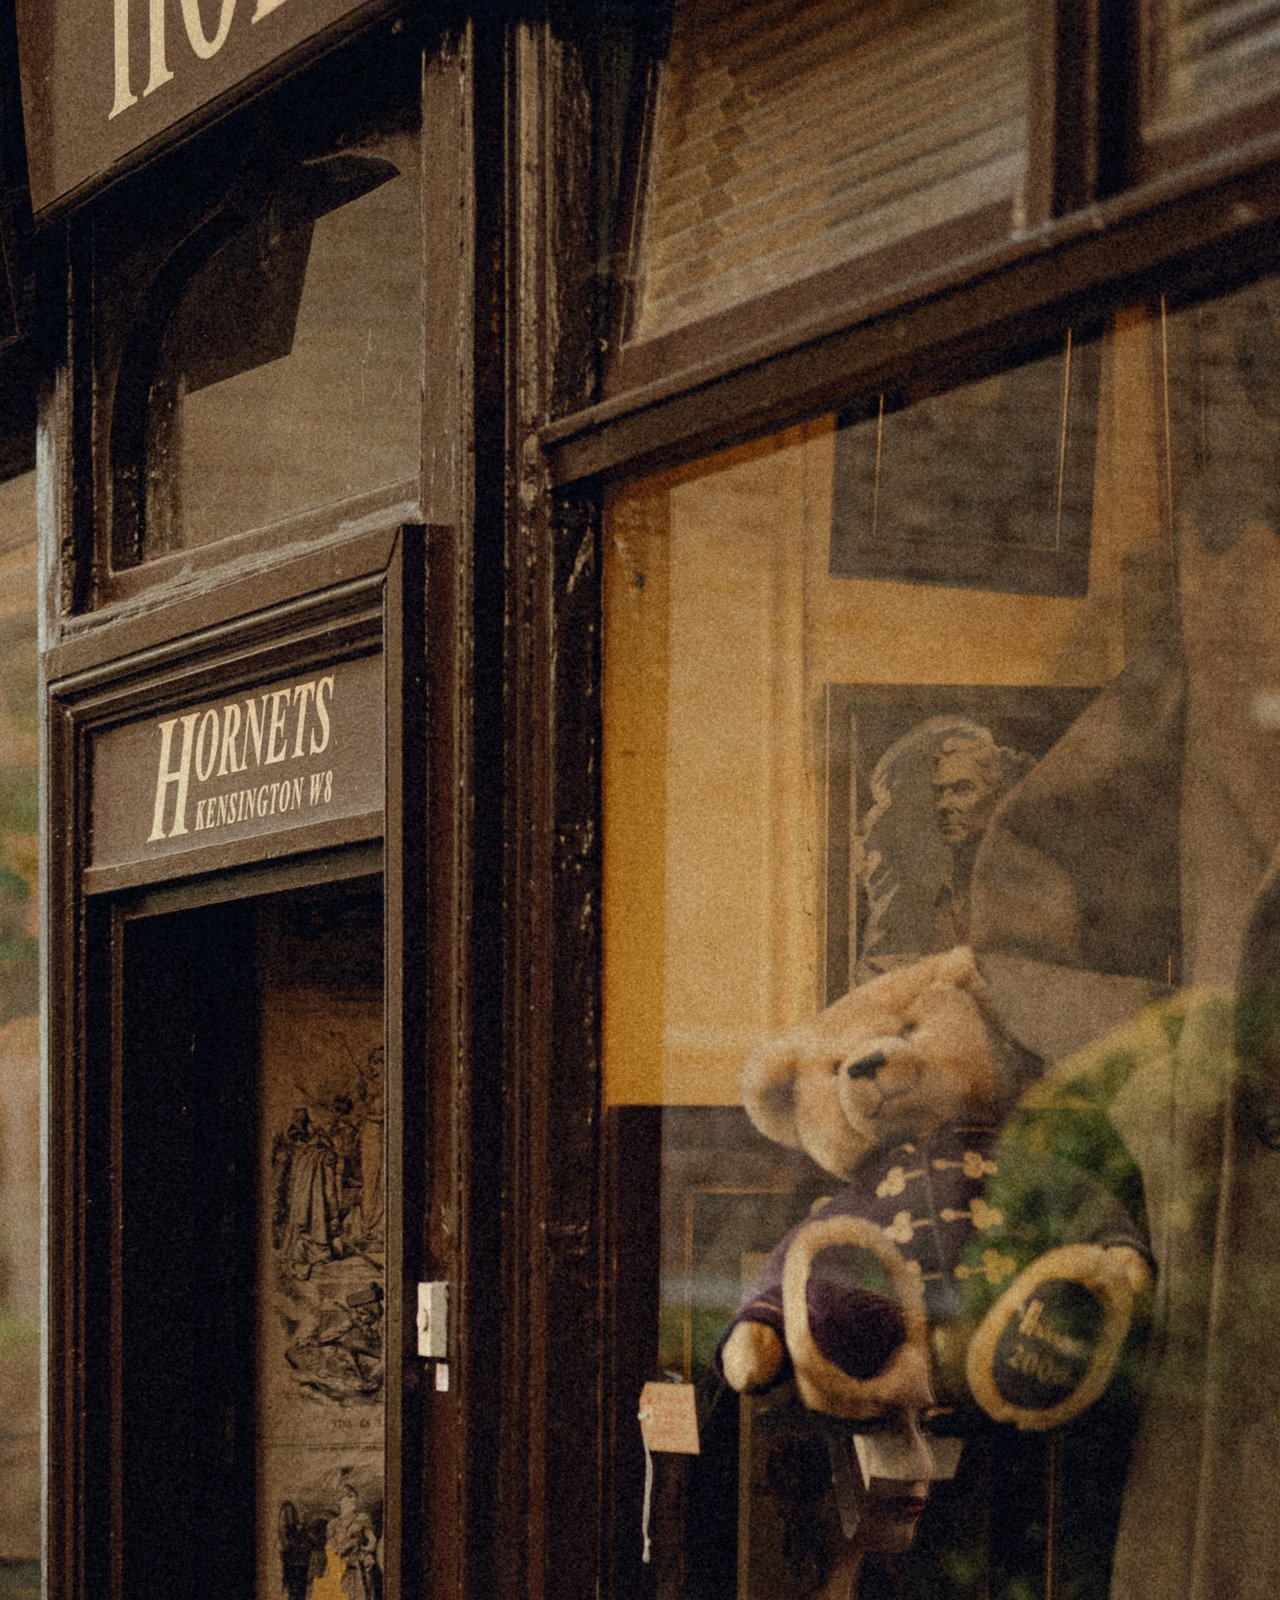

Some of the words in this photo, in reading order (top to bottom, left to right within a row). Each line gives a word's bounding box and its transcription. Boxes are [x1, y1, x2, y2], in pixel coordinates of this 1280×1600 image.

[146, 674, 336, 842] HORNETS
[194, 776, 304, 831] KENSINGTON
[309, 769, 334, 807] W8
